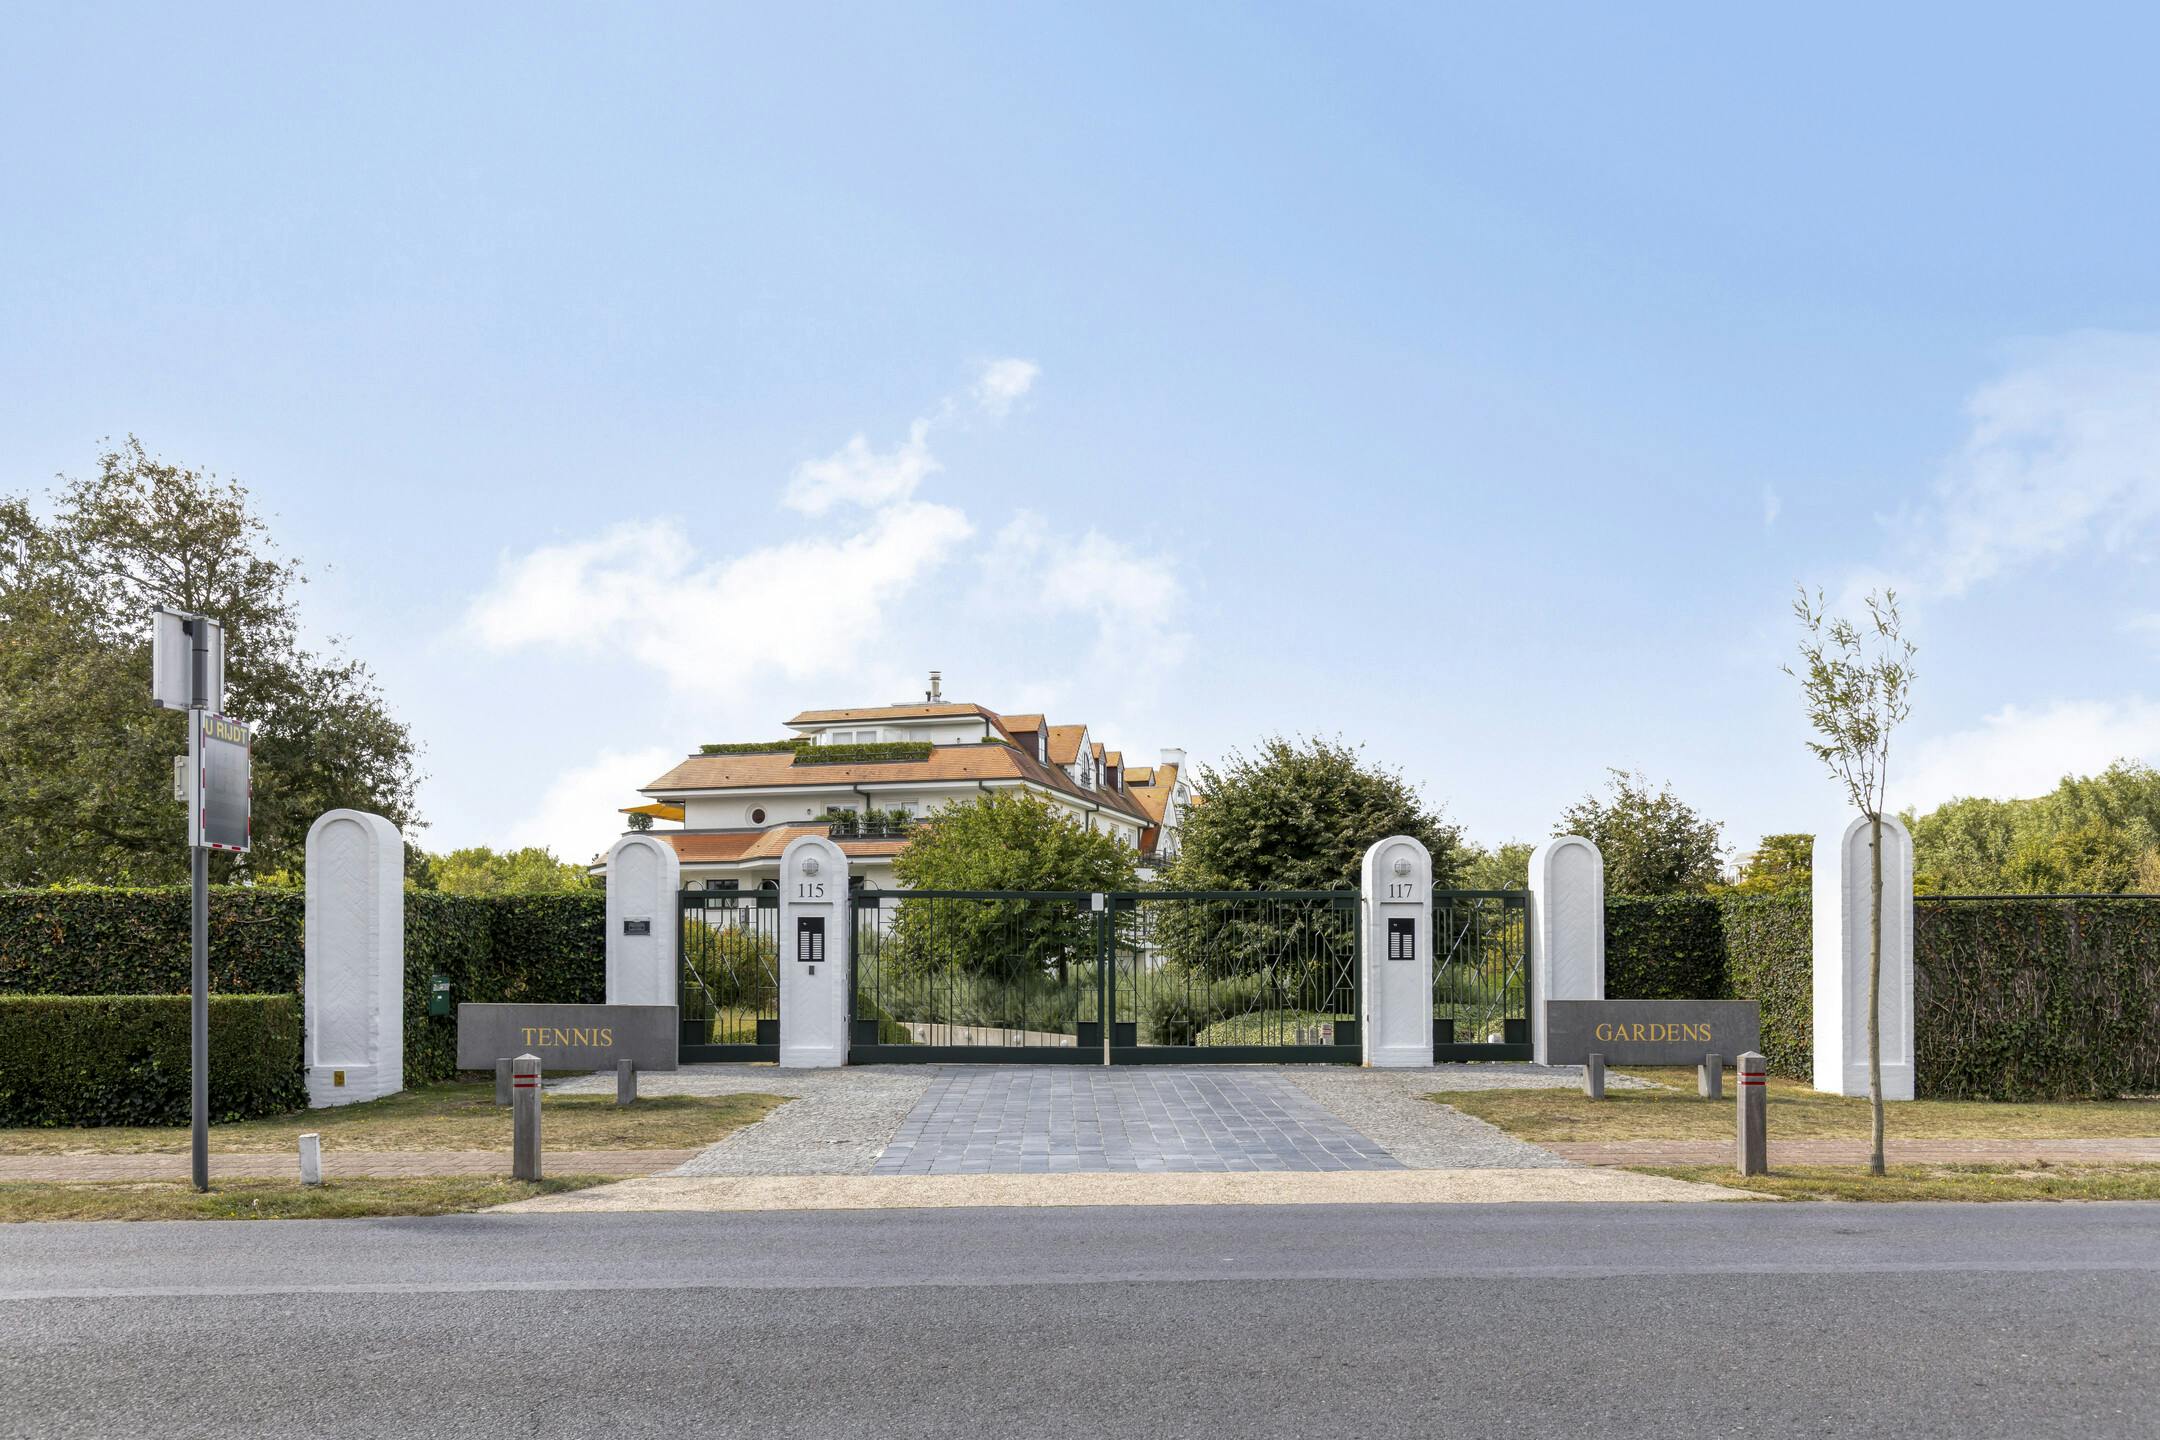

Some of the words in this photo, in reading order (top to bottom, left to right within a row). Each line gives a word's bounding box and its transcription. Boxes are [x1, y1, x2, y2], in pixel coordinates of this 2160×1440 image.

[205, 718, 214, 736] U
[216, 720, 248, 745] RIJDT
[798, 882, 825, 898] 115
[1388, 883, 1413, 899] 117
[521, 1027, 613, 1047] TENNIS
[1595, 1023, 1712, 1042] GARDENS
